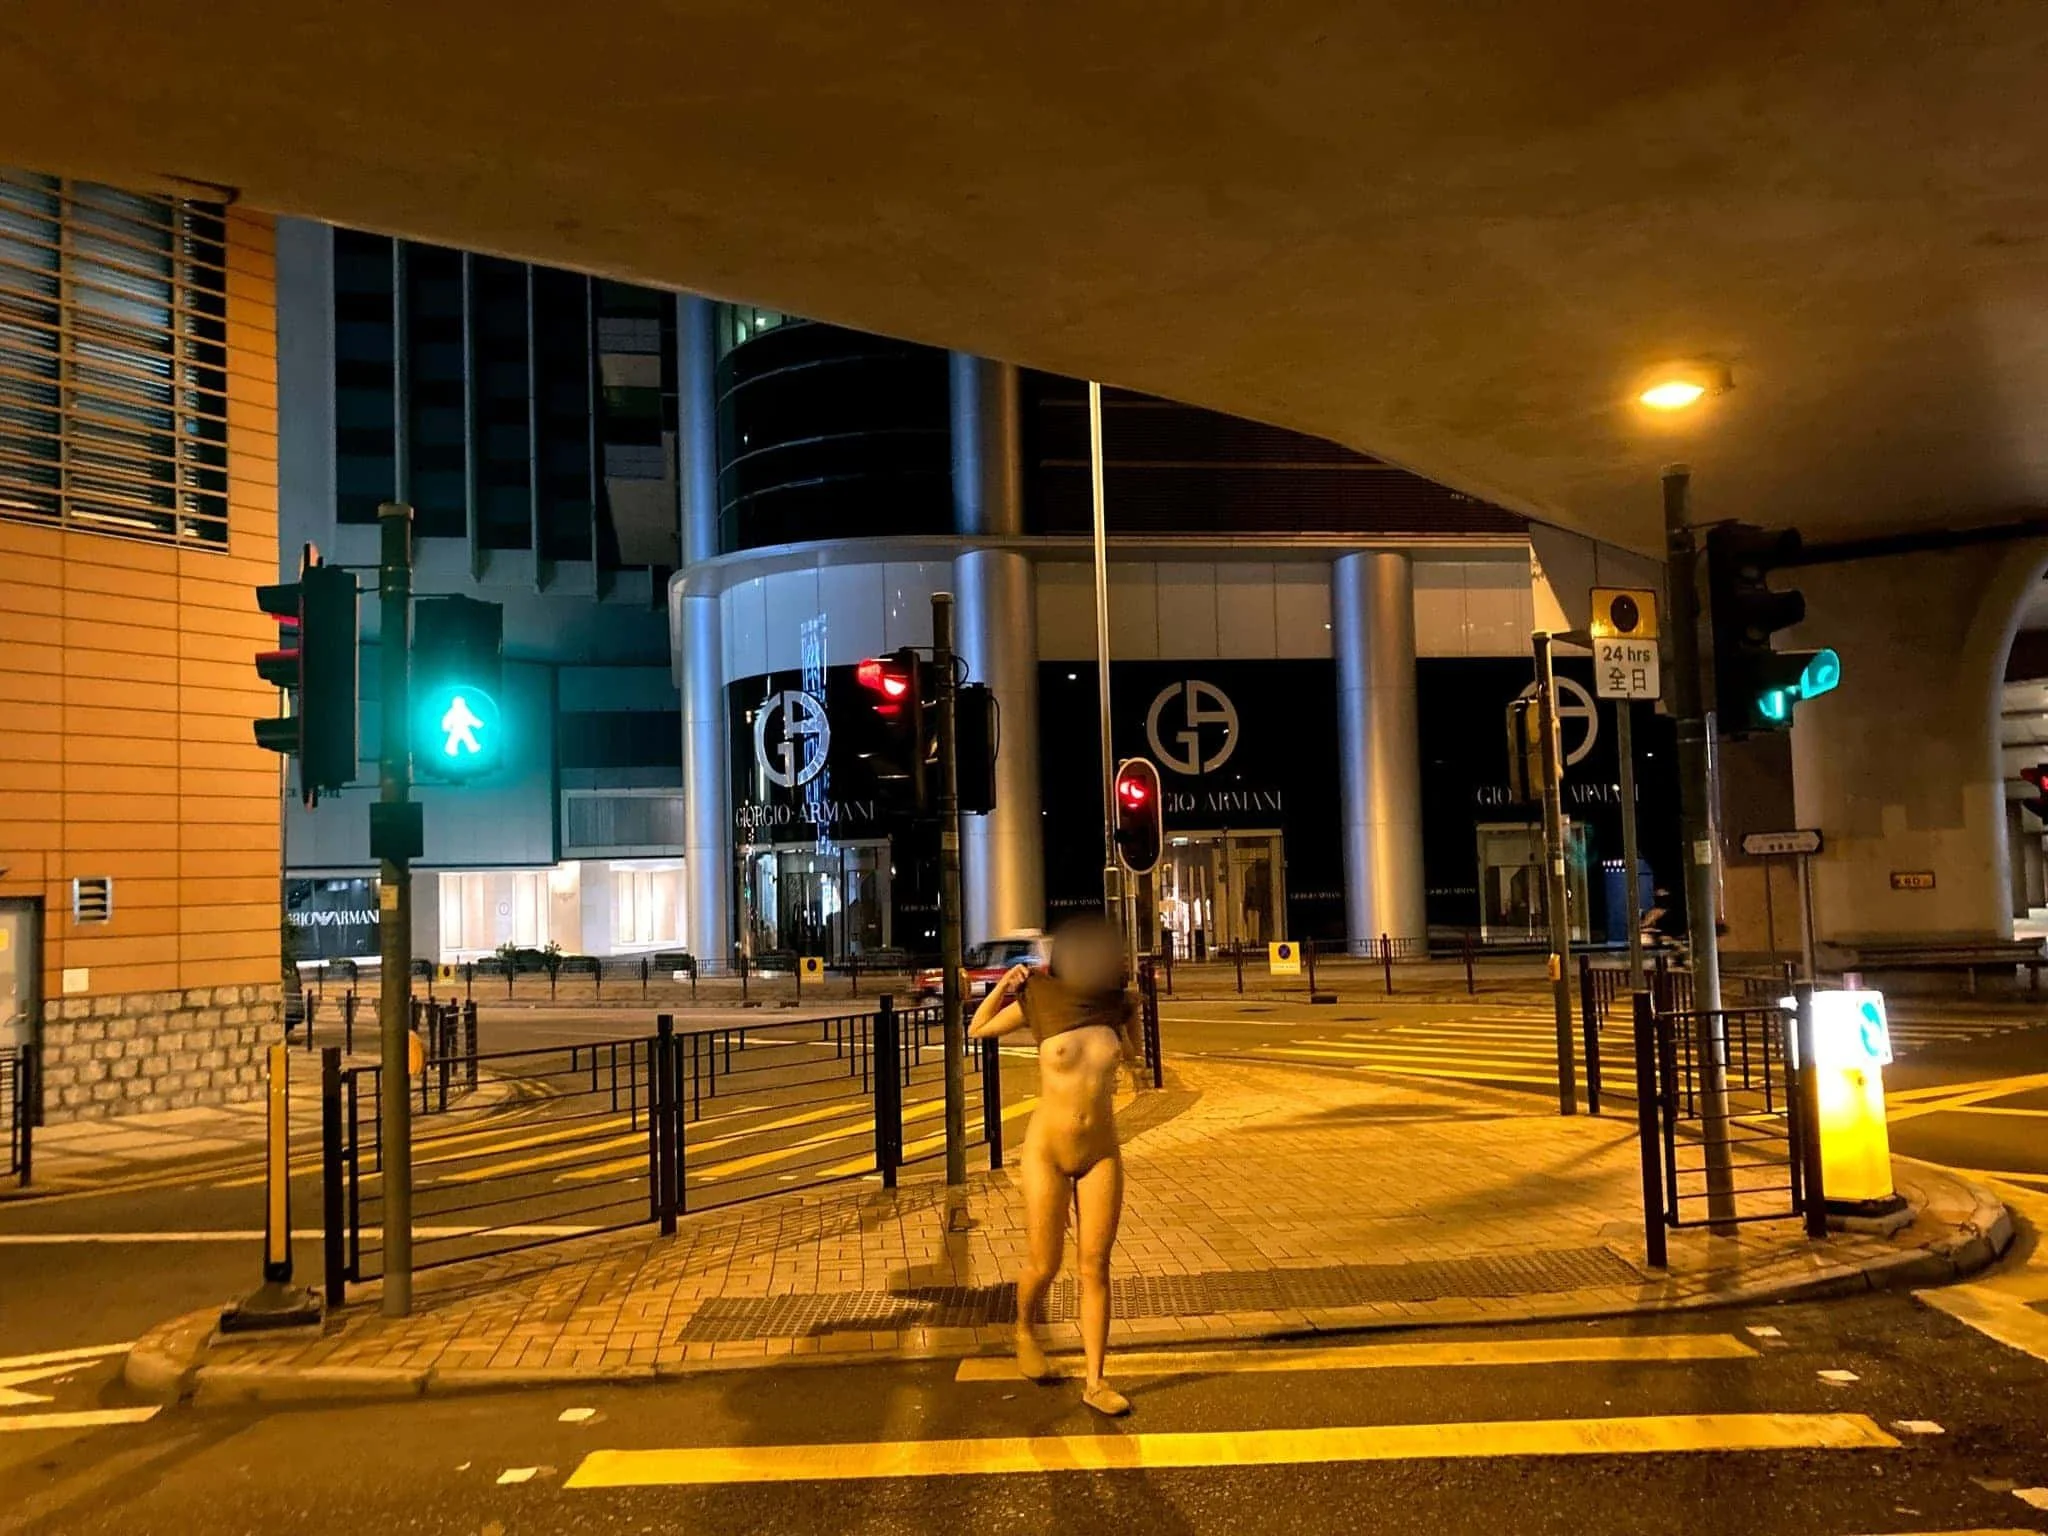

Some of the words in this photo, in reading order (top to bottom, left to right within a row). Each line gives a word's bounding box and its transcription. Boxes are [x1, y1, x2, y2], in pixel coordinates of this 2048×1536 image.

[1603, 646, 1623, 662] 24
[1628, 646, 1650, 662] hrs
[1609, 667, 1646, 691] 全日
[1205, 790, 1282, 812] ARMANI
[1568, 783, 1639, 804] ARMAI
[736, 803, 791, 827] GIORGIO
[799, 800, 876, 824] ARMANI
[331, 909, 380, 926] ARMANI
